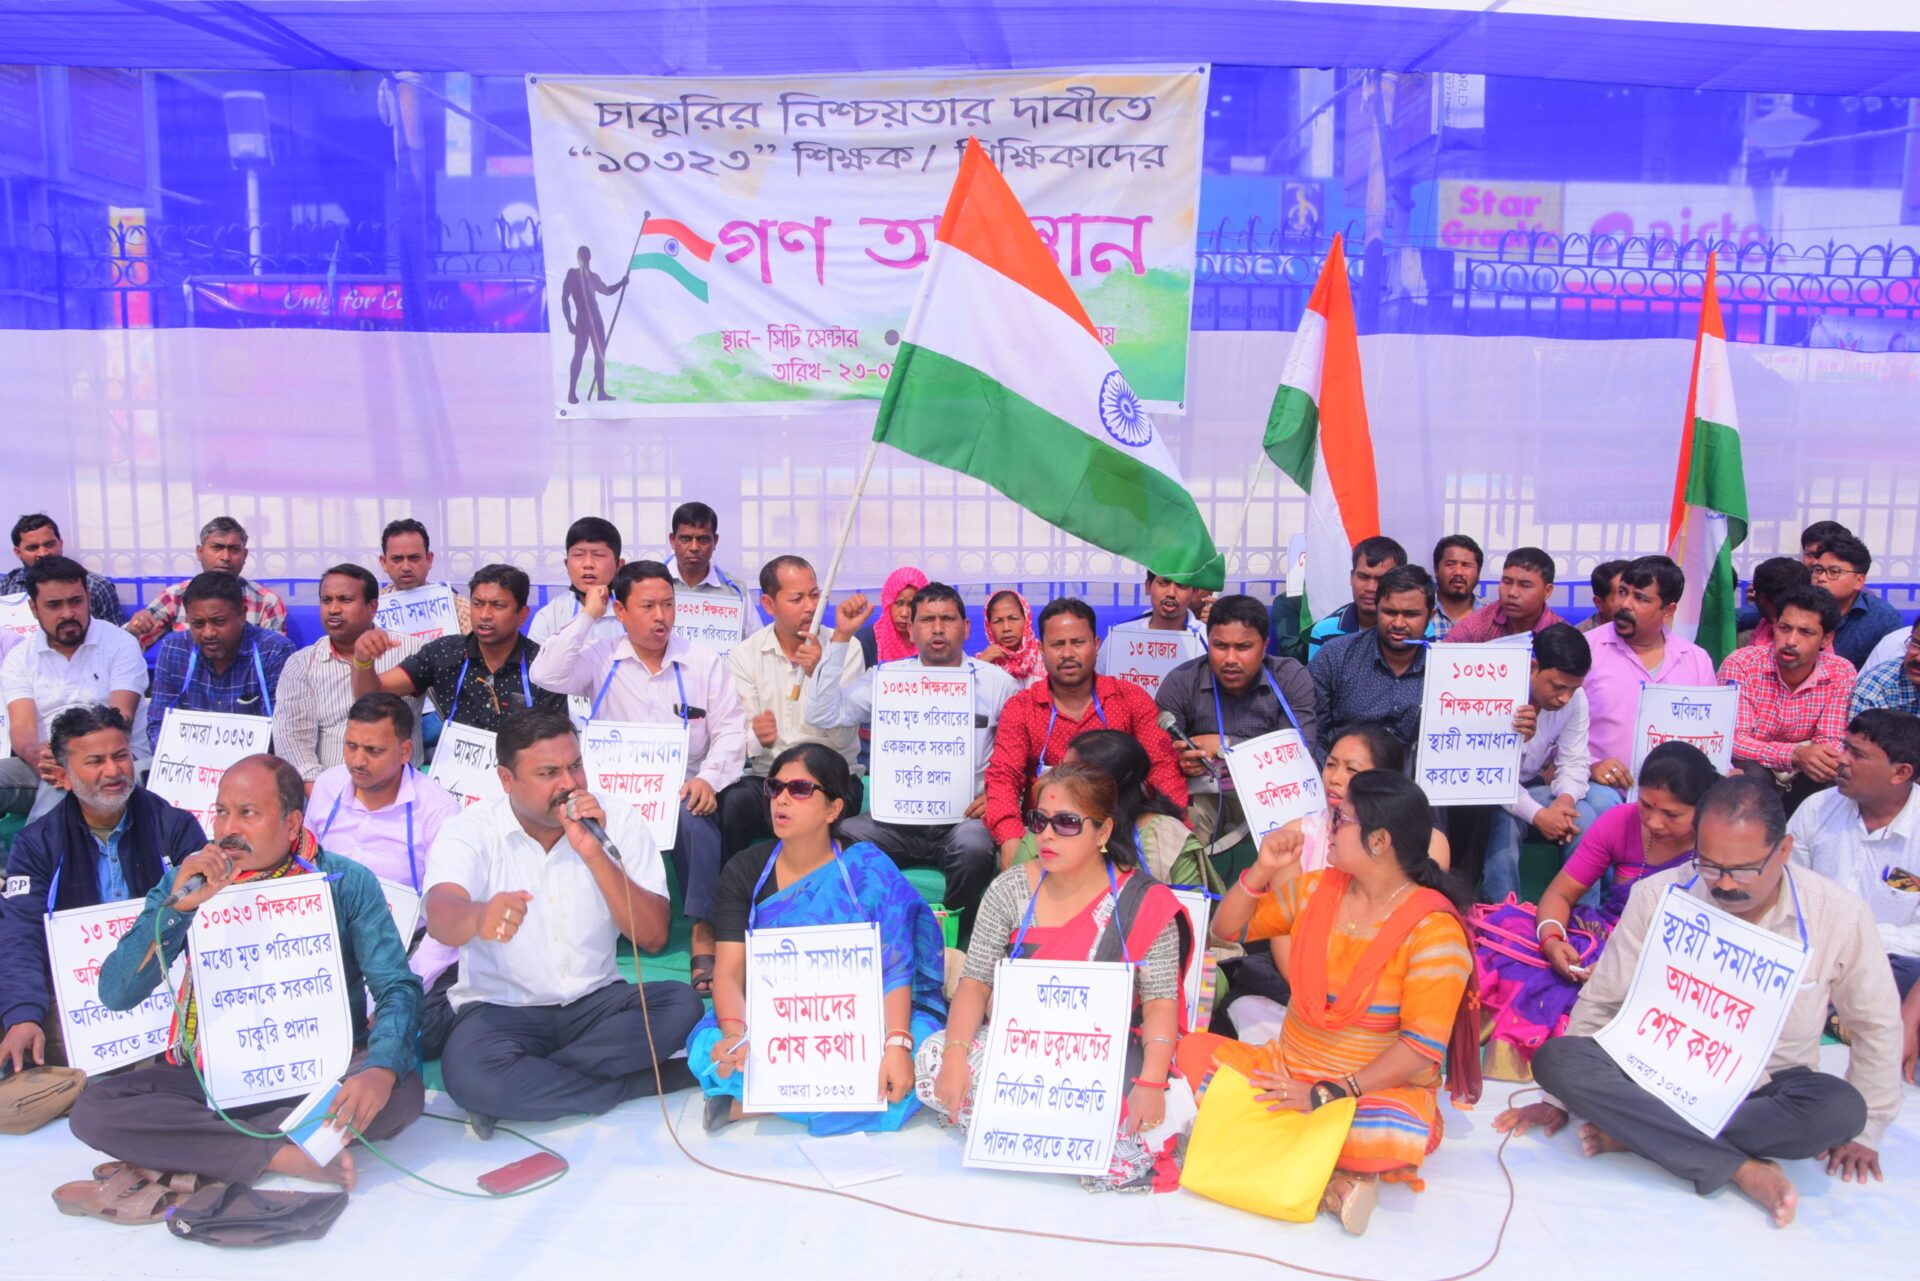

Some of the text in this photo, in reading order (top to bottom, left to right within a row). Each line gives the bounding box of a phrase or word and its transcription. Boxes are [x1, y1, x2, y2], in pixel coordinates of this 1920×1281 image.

[594, 86, 1155, 138] চাকুরির নিশ্চয়তার দাবীতে
[1458, 185, 1542, 217] Star
[717, 217, 832, 286] গণ
[343, 290, 377, 313] for
[767, 324, 801, 351] সিটি
[806, 326, 859, 347] সেন্টার
[839, 363, 896, 382] ২৩-০
[405, 597, 450, 621] সমাধান
[677, 603, 700, 616] ০৩২৩
[1129, 641, 1178, 659] ১৩ হাজার
[1452, 662, 1509, 681] ১০৩২৩
[883, 676, 967, 697] ১০৩২৩ শিক্ষকদের
[1439, 691, 1515, 717] শিক্ষকদের
[1671, 696, 1713, 721] অবিলম্বে
[878, 706, 970, 731] মধ্যে মৃত পরিবারের
[180, 722, 255, 750] আমরা ১০৩২৩
[881, 736, 966, 757] একজনকে সরকারি
[1427, 726, 1519, 754] স্থায়ী সমাধান
[454, 738, 486, 770] আমরা
[1253, 751, 1273, 769] ১৩
[157, 753, 196, 785] নির্দোষ
[598, 771, 665, 795] আমাদের
[894, 765, 952, 789] চাকুরি প্রদান
[1425, 767, 1471, 786] করতে
[893, 799, 924, 816] করতে
[1254, 781, 1301, 808] অশিক্ষক
[200, 893, 324, 929] ১০৩২৩ শিক্ষকদের
[80, 923, 103, 945] ১৩
[199, 932, 333, 972] মধ্যে মৃত পরিবারের
[804, 944, 874, 983] সমাধান
[1662, 910, 1796, 1000] স্থায়ী সমাধান
[212, 967, 334, 1012] একজনকে সরকারি
[1036, 975, 1091, 1012] অবিলম্বে
[1665, 964, 1757, 1035] আমাদের
[772, 991, 857, 1024] আমাদের
[236, 1016, 320, 1053] চাকুরি প্রদান
[1003, 1017, 1041, 1060] ভিশন
[1636, 1006, 1688, 1053] শেষ
[91, 1034, 141, 1061] করতে
[766, 1032, 809, 1065] শেষ
[241, 1063, 286, 1091] করতে
[1626, 1052, 1699, 1107] আমরা ১০৩২৩
[777, 1083, 856, 1100] আমরা ১০৩২৩
[992, 1071, 1108, 1114] নির্বাচনী প্রতিশ্রুতি
[982, 1127, 1021, 1158] পালন
[1021, 1132, 1065, 1160] করতে
